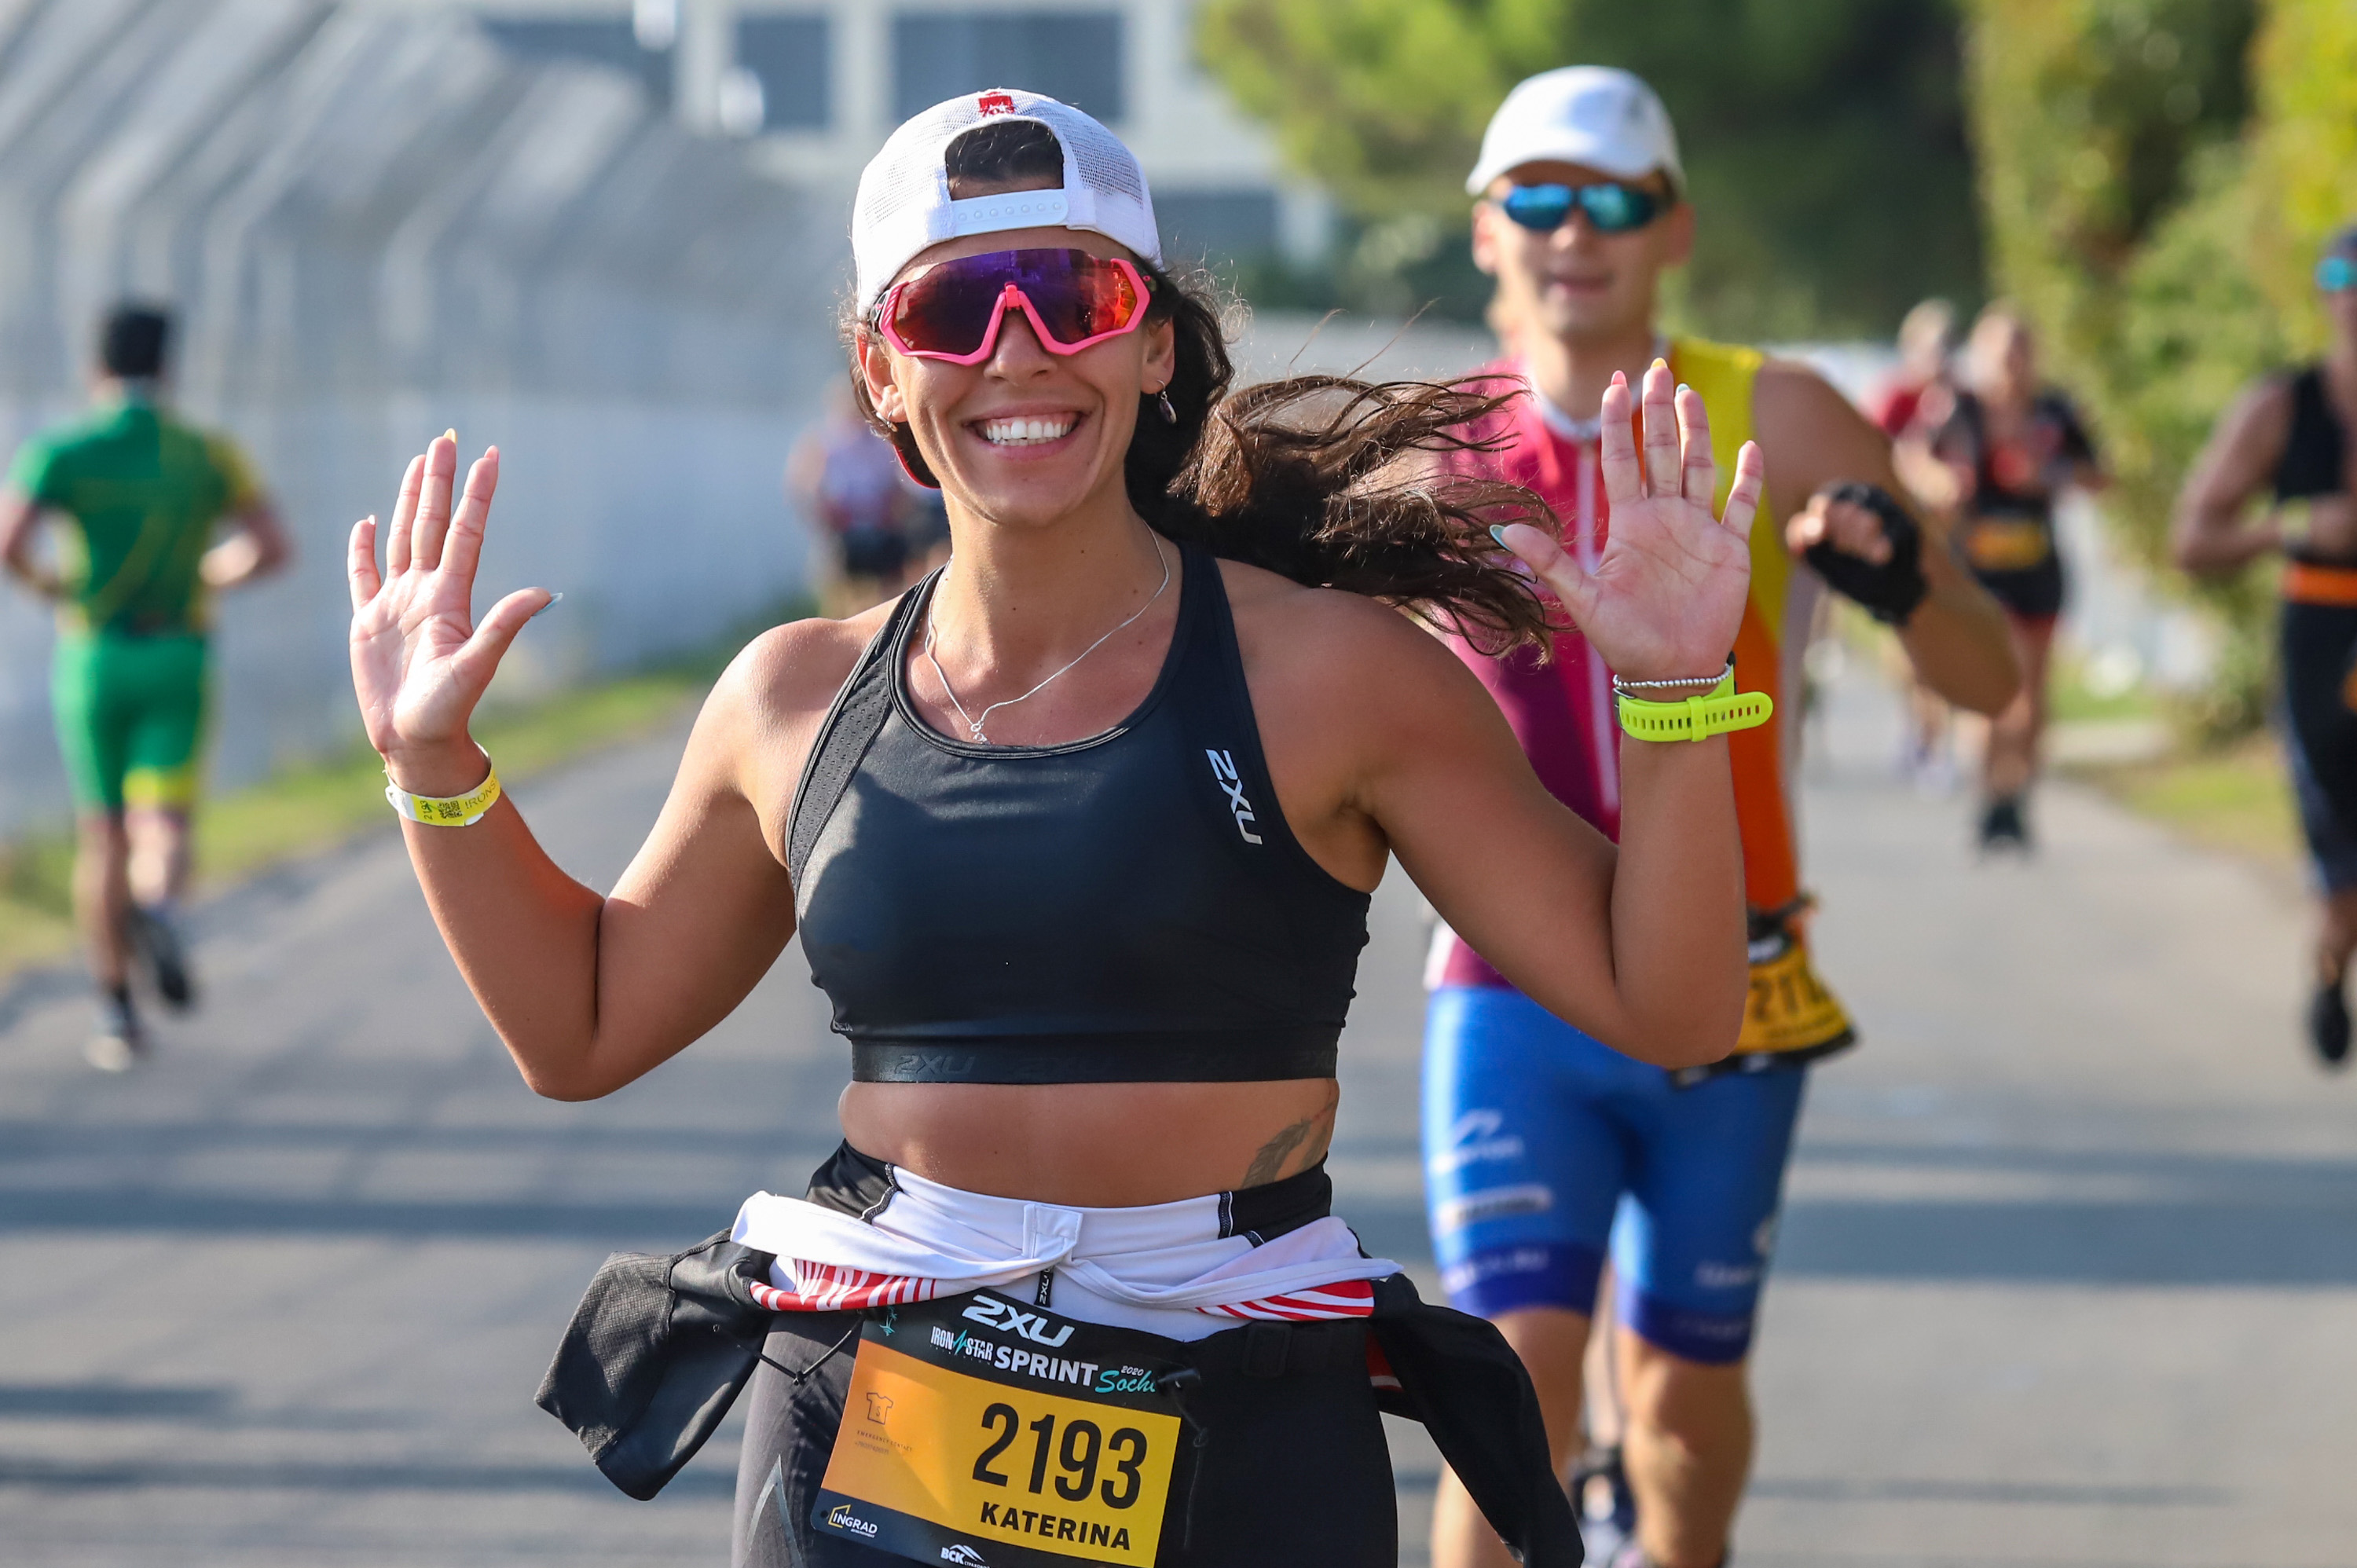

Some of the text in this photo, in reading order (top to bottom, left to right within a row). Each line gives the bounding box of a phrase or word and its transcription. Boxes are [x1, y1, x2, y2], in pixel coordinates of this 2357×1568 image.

[465, 775, 498, 809] IRONS
[1205, 749, 1263, 845] 2XU
[895, 1054, 975, 1074] 2XU
[962, 1294, 1075, 1348] 2XU
[994, 1346, 1099, 1387] SPRINT
[1120, 1365, 1145, 1376] 2020
[972, 1402, 1147, 1509] 2193
[833, 1512, 878, 1534] INGRAD
[980, 1501, 1130, 1550] KATERINA
